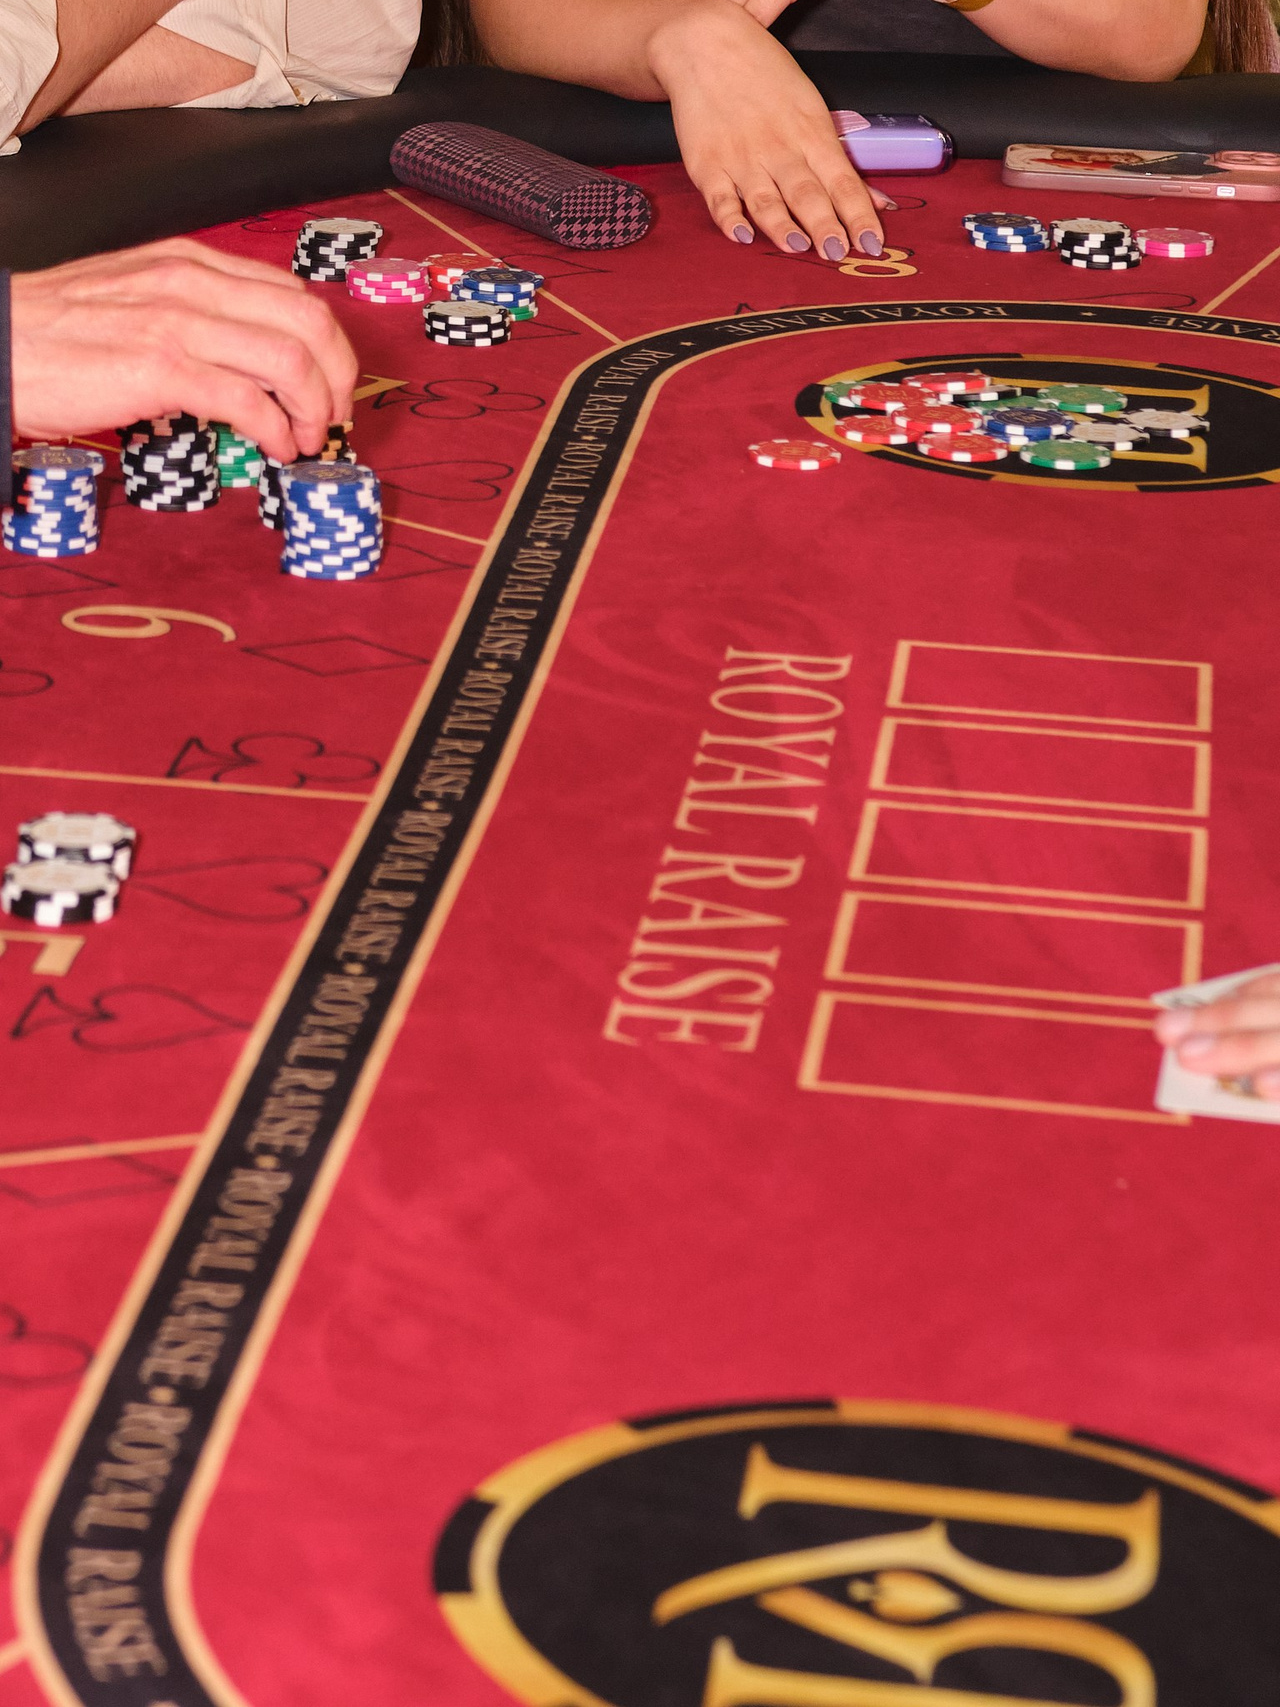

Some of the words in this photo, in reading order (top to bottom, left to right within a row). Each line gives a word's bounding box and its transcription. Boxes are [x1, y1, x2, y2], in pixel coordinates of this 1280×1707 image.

[714, 310, 845, 337] RAISE
[844, 305, 1011, 320] ROYAL
[594, 348, 677, 388] ROYAL
[573, 393, 628, 434] RAISE
[547, 441, 608, 490] ROYAL
[526, 493, 585, 540] RAISE
[497, 548, 562, 604] ROYAL
[474, 606, 538, 661] RAISE
[441, 669, 513, 735] ROYAL
[674, 645, 853, 835] ROYAL
[413, 737, 485, 801] RAISE
[371, 809, 454, 887] ROYAL
[334, 888, 418, 964] RAISE
[603, 845, 806, 1053] RAISE
